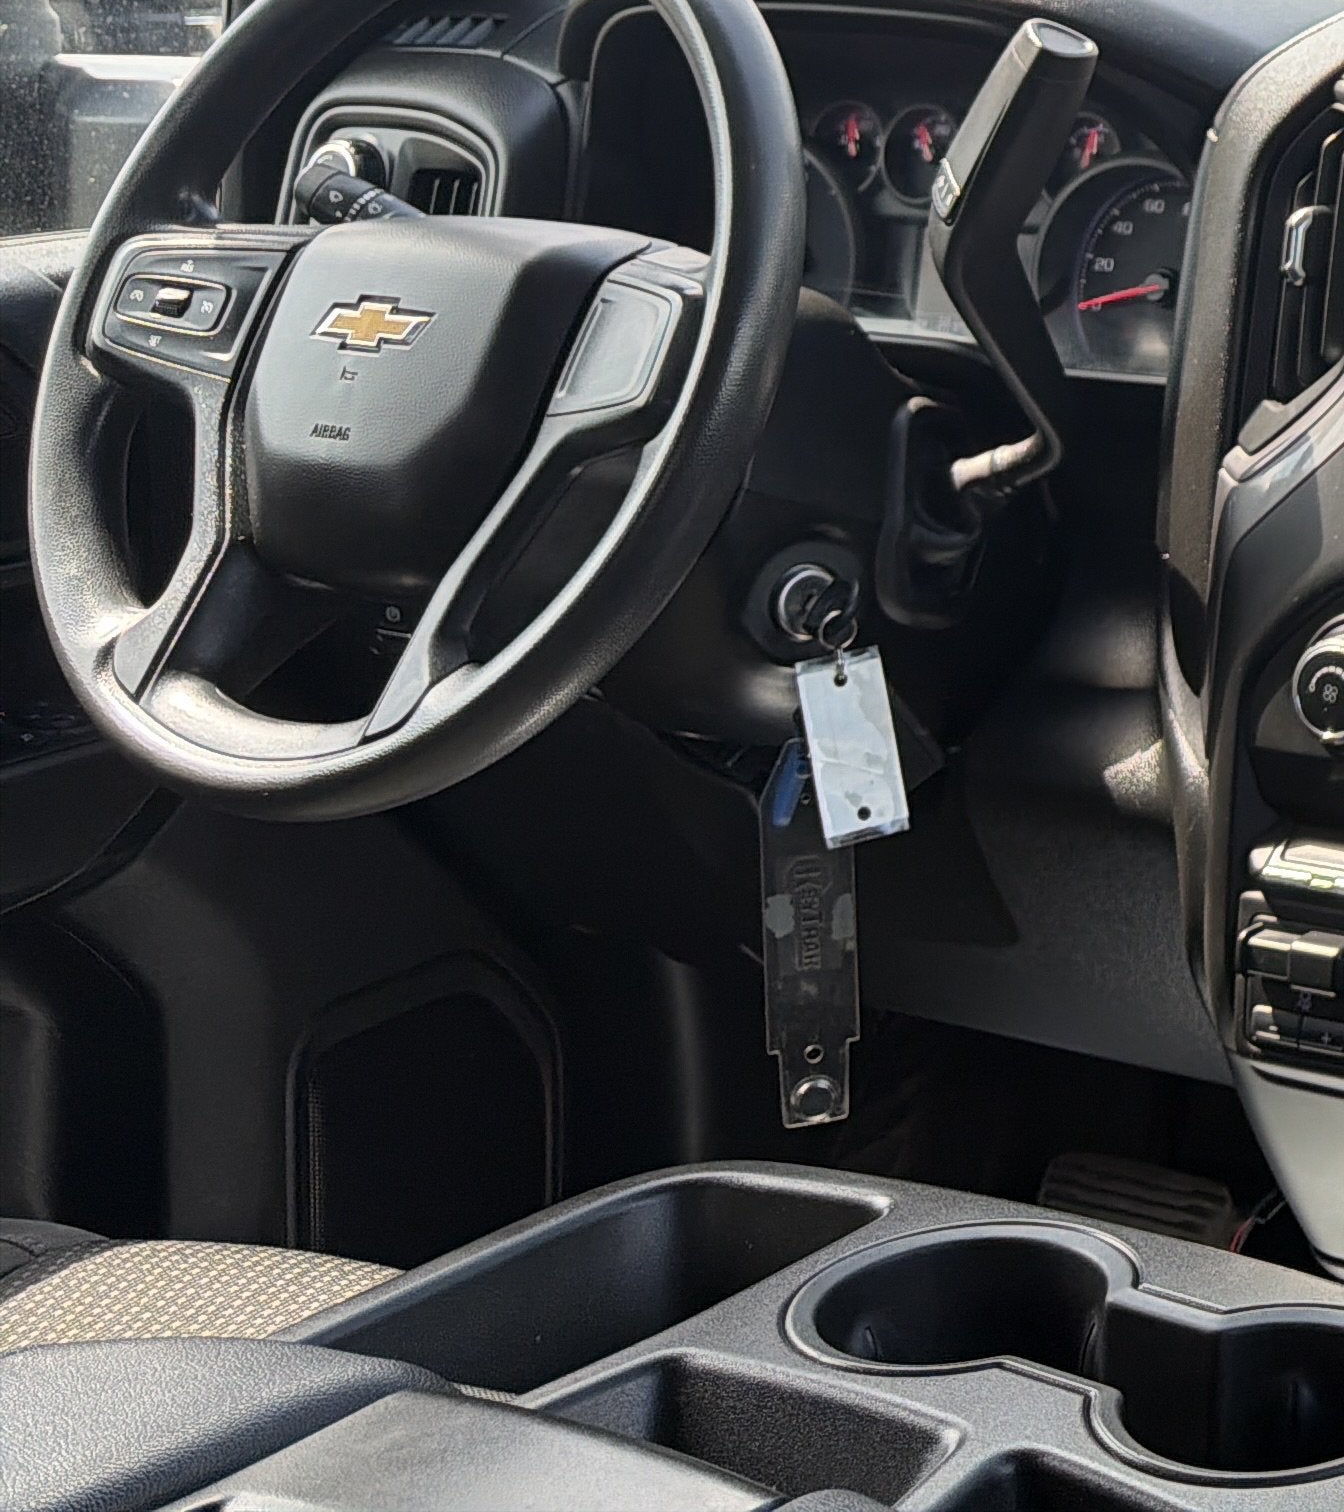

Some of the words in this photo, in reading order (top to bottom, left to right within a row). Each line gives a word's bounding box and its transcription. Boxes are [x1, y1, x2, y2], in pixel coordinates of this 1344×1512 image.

[1143, 198, 1165, 214] 60
[1112, 220, 1134, 235] 40
[1094, 256, 1115, 272] 20
[309, 422, 352, 441] AIRBAG
